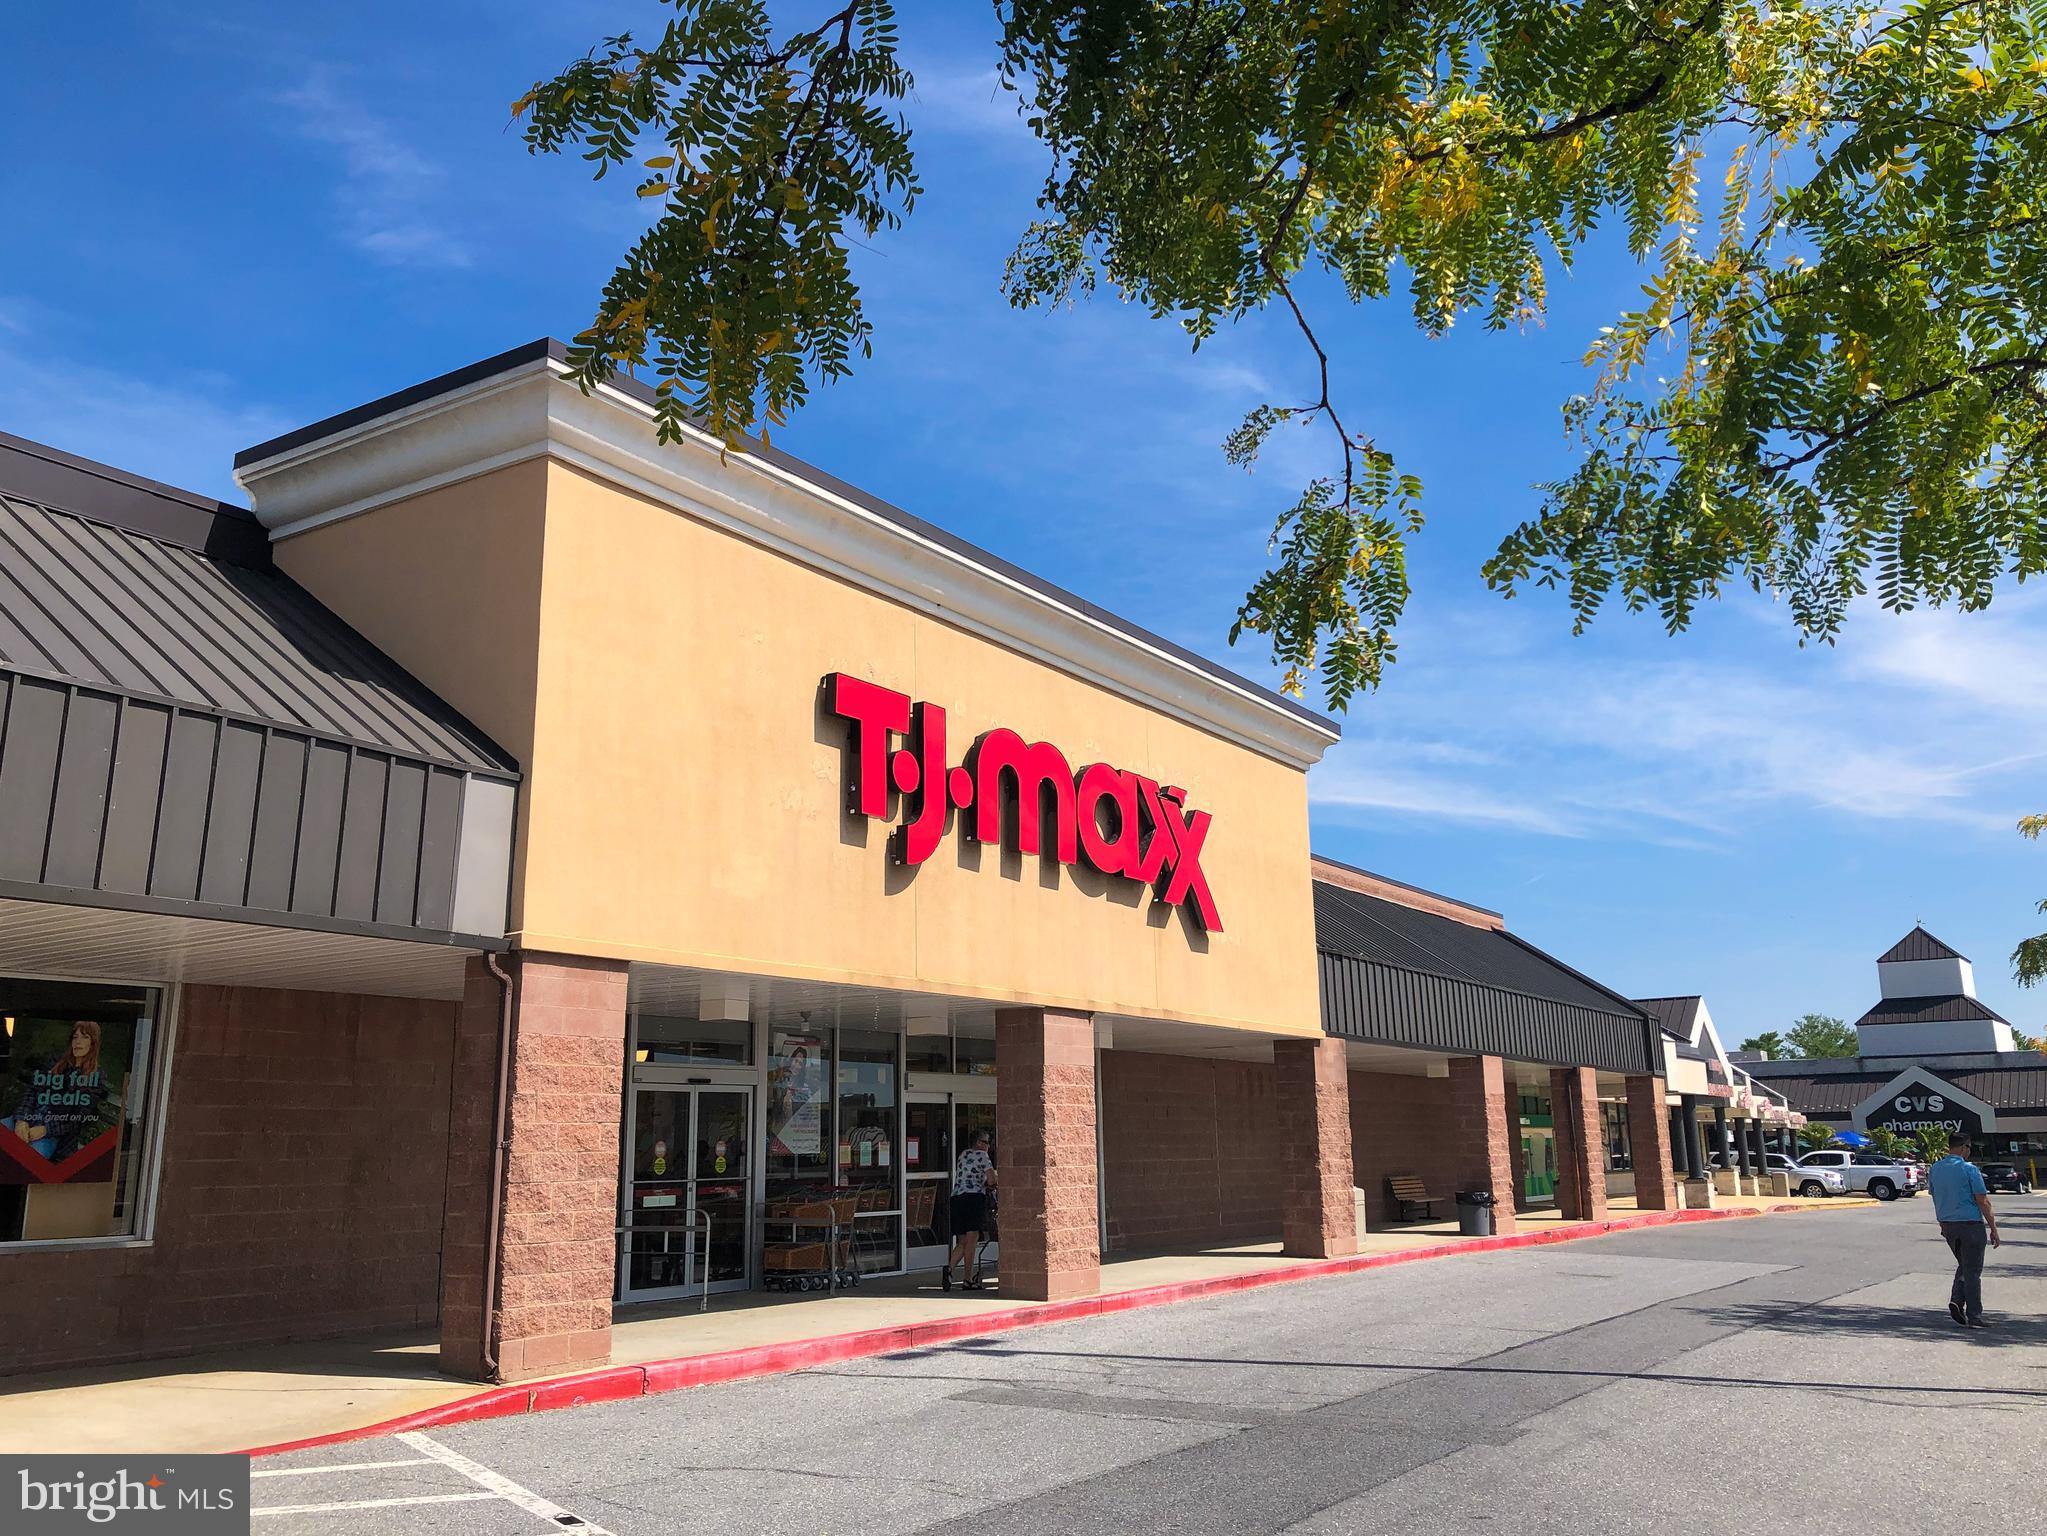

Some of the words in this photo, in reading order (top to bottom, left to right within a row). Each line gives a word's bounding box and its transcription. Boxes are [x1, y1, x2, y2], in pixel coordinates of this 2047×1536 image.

[33, 1069, 64, 1090] big
[69, 1071, 100, 1087] fall
[37, 1089, 91, 1106] deals
[1894, 1095, 1945, 1113] CVS
[44, 1113, 69, 1123] great
[81, 1114, 99, 1123] you
[1882, 1118, 1962, 1133] pharmacy
